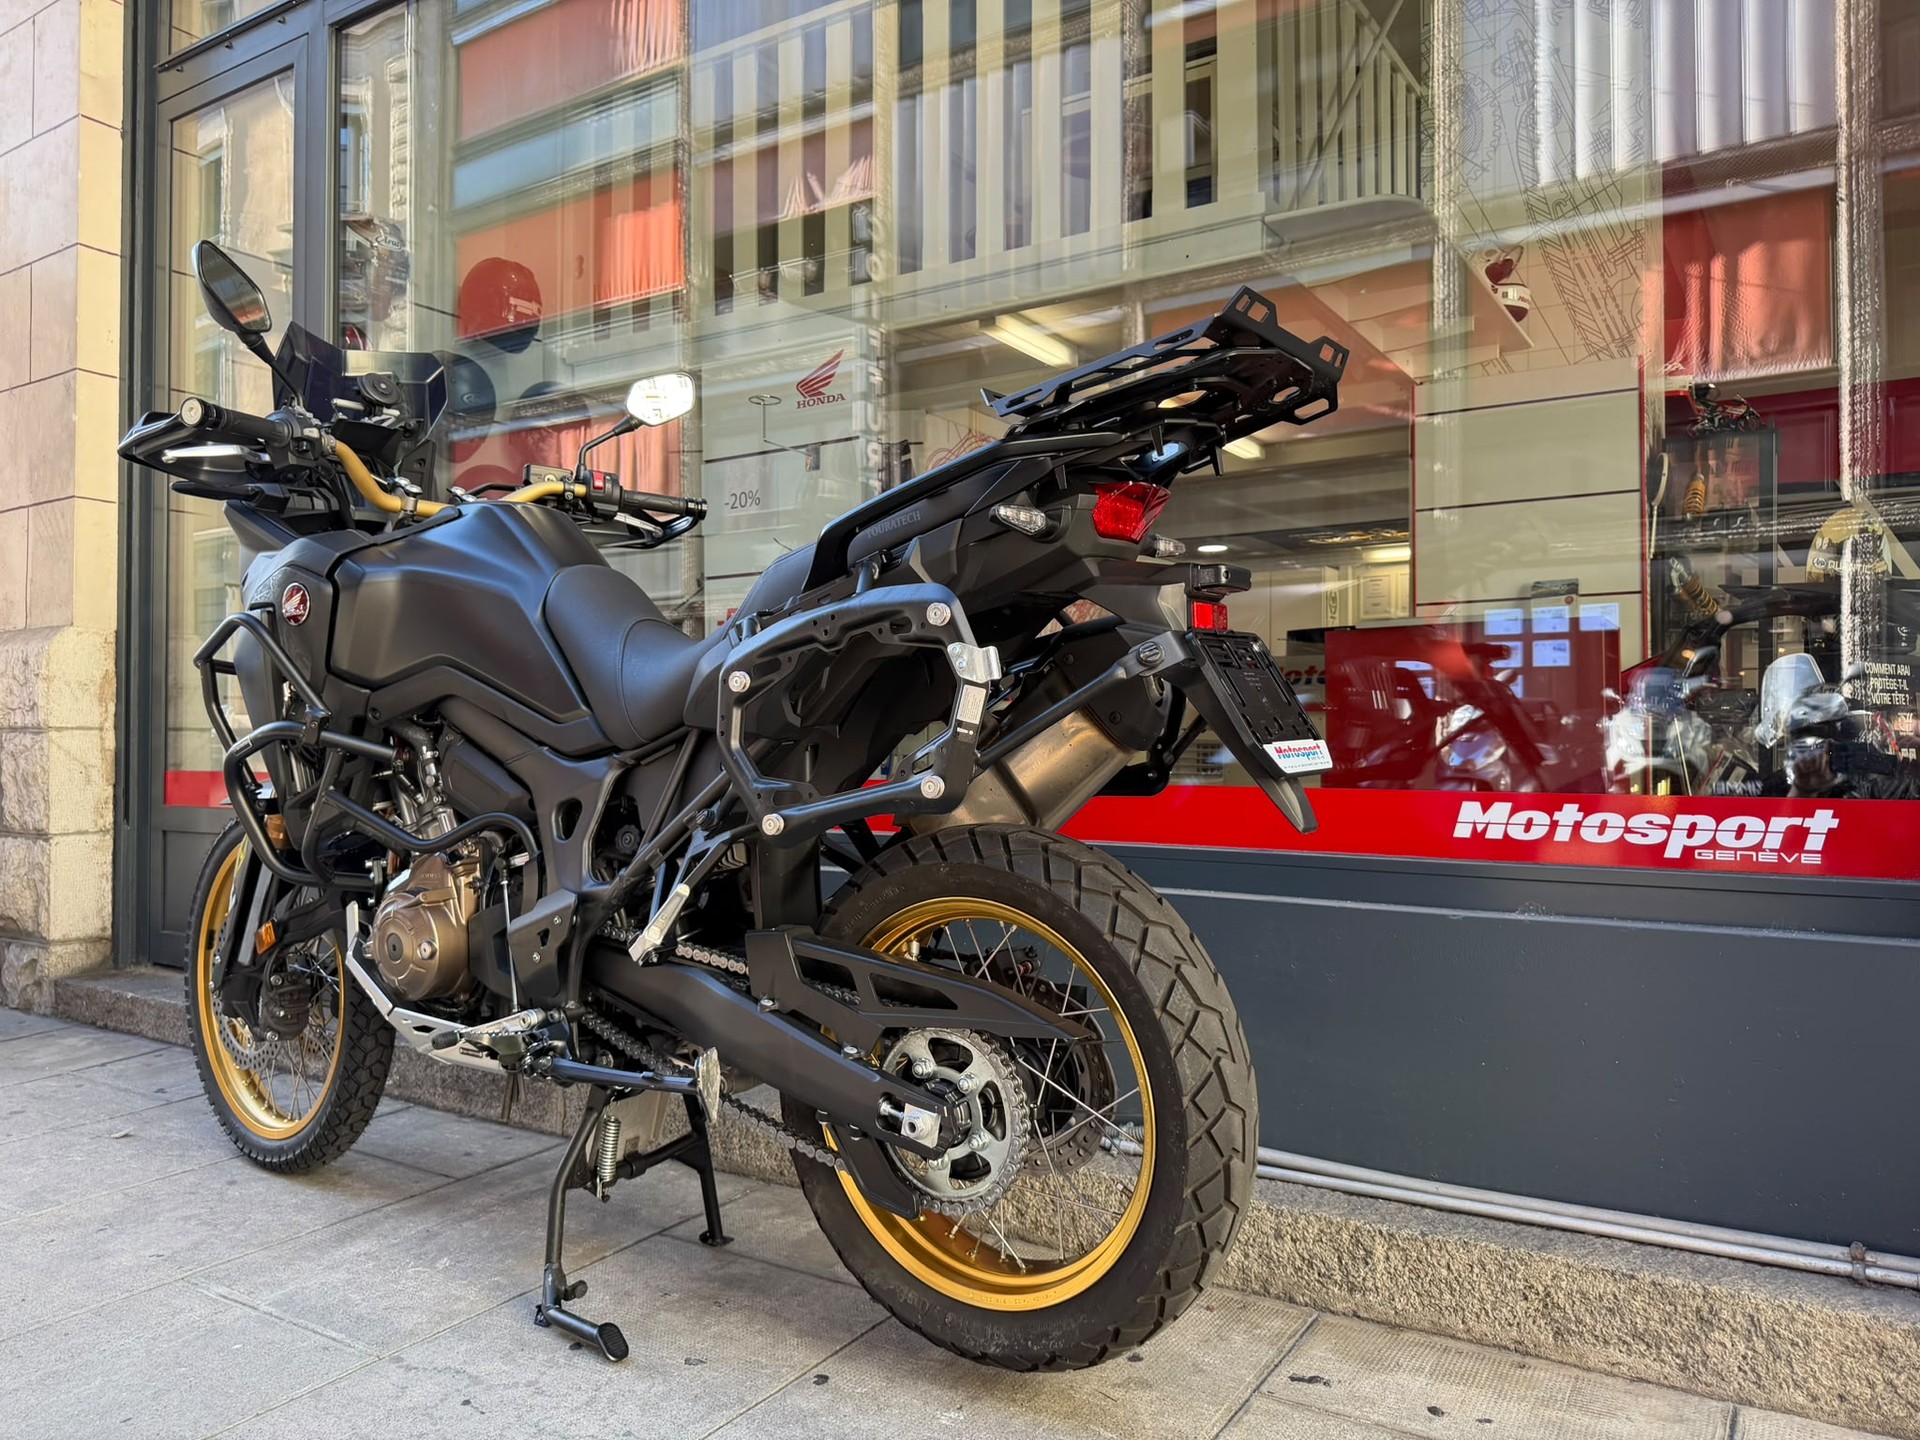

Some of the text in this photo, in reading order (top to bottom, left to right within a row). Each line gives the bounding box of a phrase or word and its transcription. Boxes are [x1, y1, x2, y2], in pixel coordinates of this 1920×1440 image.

[796, 393, 847, 410] HONDA
[724, 489, 761, 510] -20%
[1864, 662, 1911, 677] COMMENT ARAI
[1871, 692, 1892, 705] VOTRE
[1274, 743, 1323, 760] Motosport
[1453, 800, 1840, 859] Motosport
[1694, 849, 1822, 865] GENÈVE
